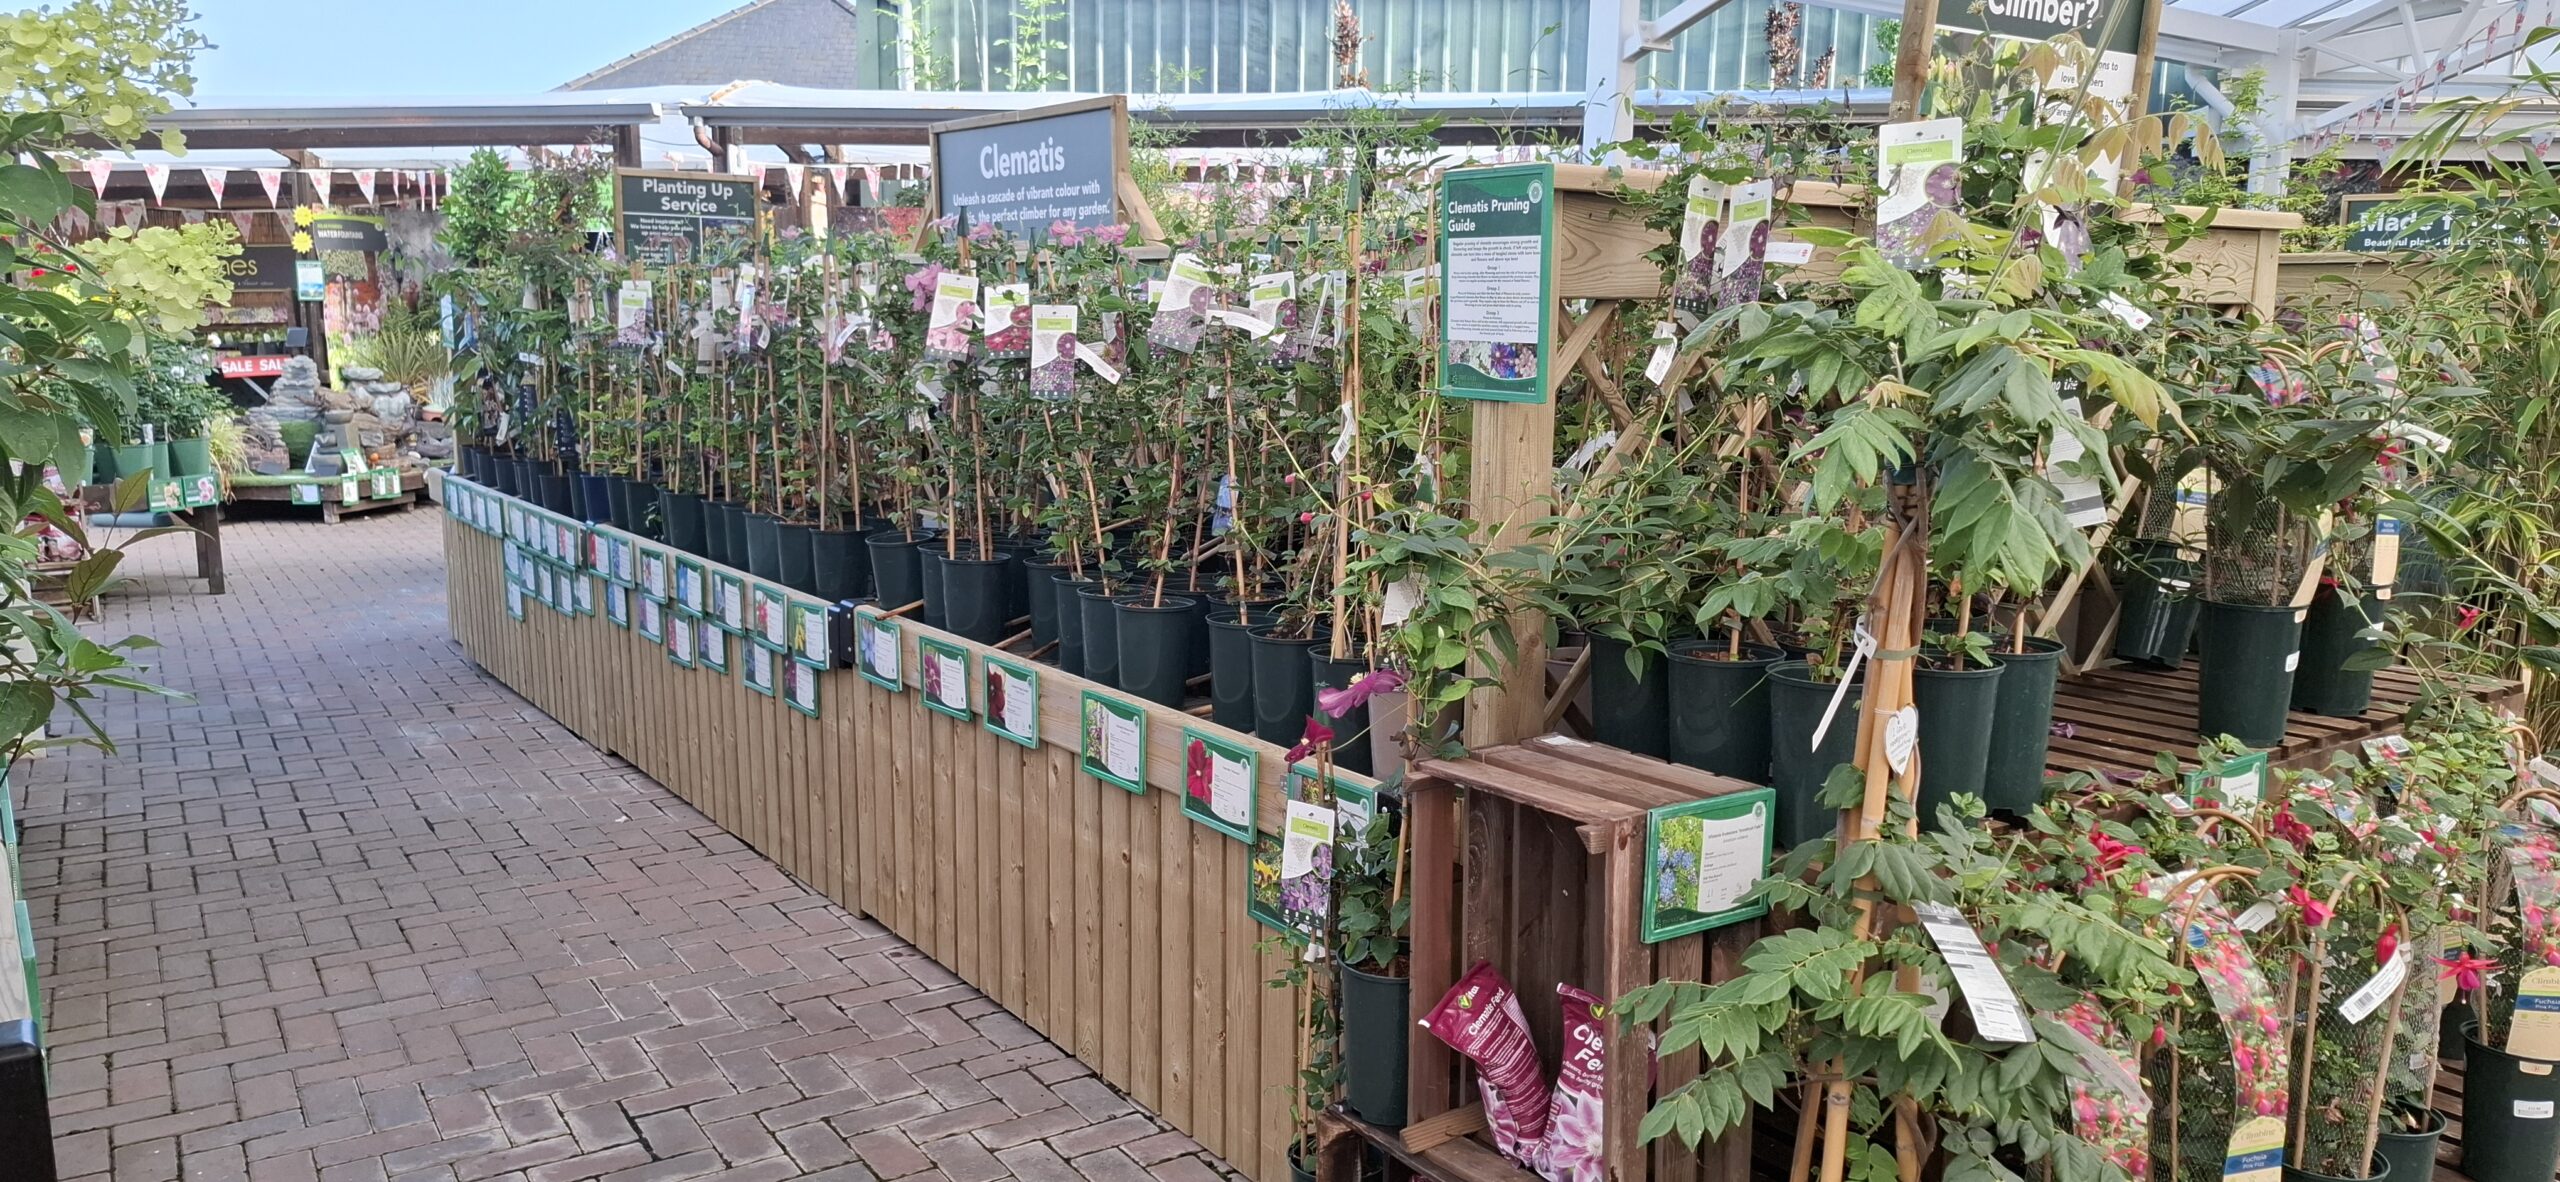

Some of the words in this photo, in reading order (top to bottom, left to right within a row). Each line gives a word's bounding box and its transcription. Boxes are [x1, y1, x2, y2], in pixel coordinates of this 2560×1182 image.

[1988, 0, 2099, 29] Climber?
[2061, 72, 2075, 83] love
[979, 136, 1065, 180] Clematis
[642, 178, 706, 199] Planting
[711, 182, 734, 200] Up
[953, 193, 980, 207] Unleash
[981, 196, 986, 204] a
[987, 189, 1016, 204] cascade
[1016, 186, 1025, 201] of
[1026, 184, 1054, 200] vibrant
[1055, 182, 1081, 198] colour
[1081, 179, 1101, 195] with
[661, 196, 718, 213] Service
[978, 210, 990, 223] the
[991, 207, 1018, 224] perfect
[1019, 205, 1048, 221] climber
[1049, 203, 1061, 218] for
[1062, 205, 1077, 222] any
[1448, 200, 1488, 214] Clematis
[1491, 198, 1530, 214] Pruning
[1448, 218, 1476, 232] Guide
[2364, 237, 2408, 247] Beautul
[222, 359, 253, 374] SALE
[259, 358, 290, 371] SAL
[2531, 977, 2560, 985] Climb
[1469, 1003, 1495, 1036] Clematis
[1491, 986, 1505, 1007] Feed
[1573, 1024, 1604, 1055] Cle
[1574, 1047, 1604, 1071] Fe
[2242, 1154, 2268, 1164] Fuchsia
